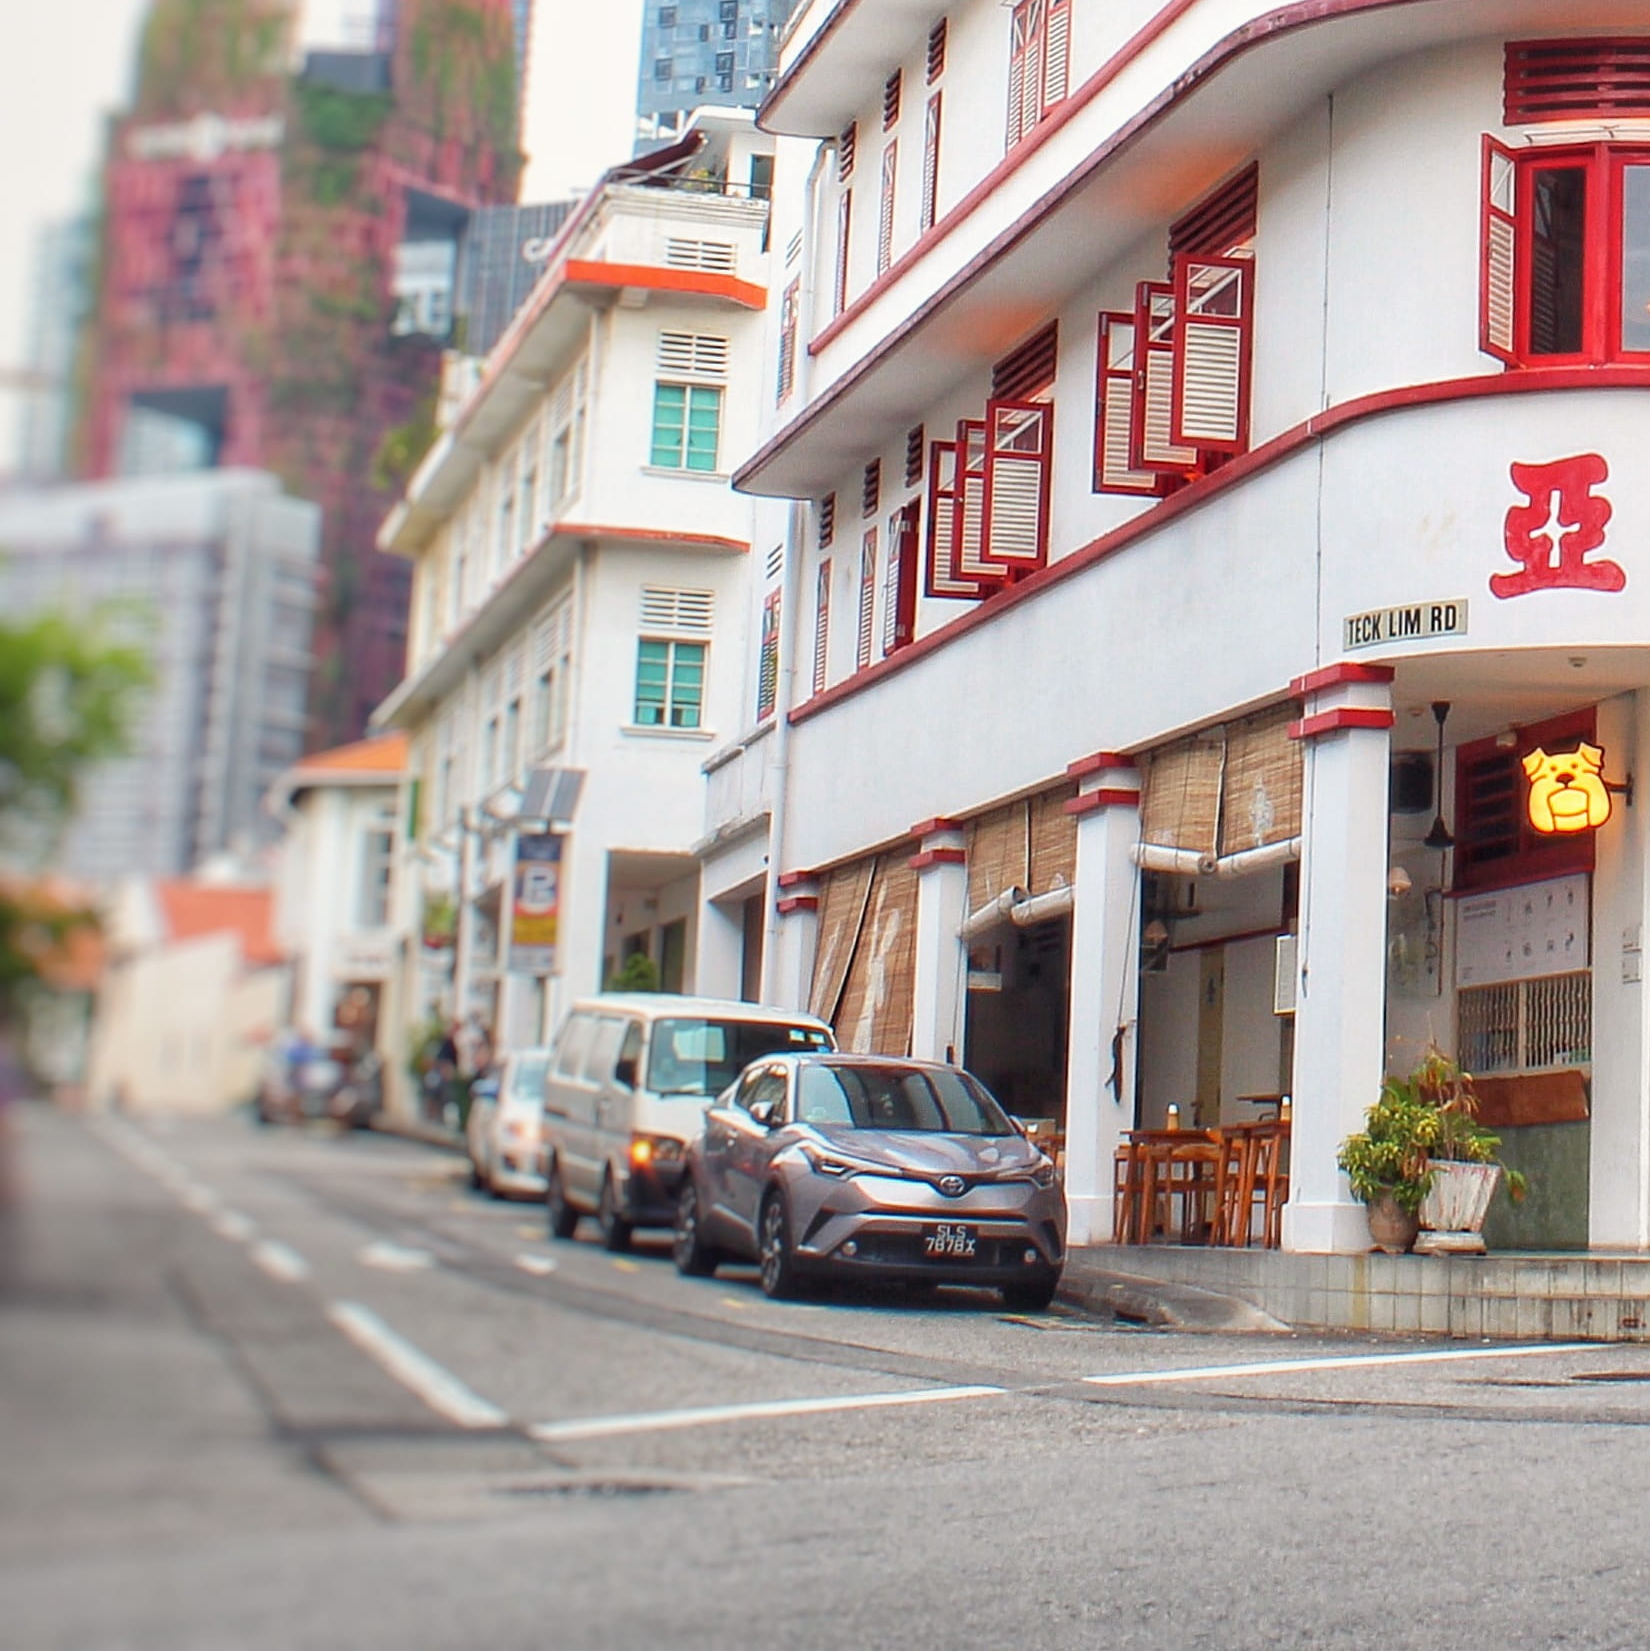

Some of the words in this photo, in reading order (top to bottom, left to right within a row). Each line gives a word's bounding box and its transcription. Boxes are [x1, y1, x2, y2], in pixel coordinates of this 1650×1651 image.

[1348, 612, 1382, 646] TECK
[1388, 607, 1422, 638] LIM
[1430, 604, 1457, 633] RD
